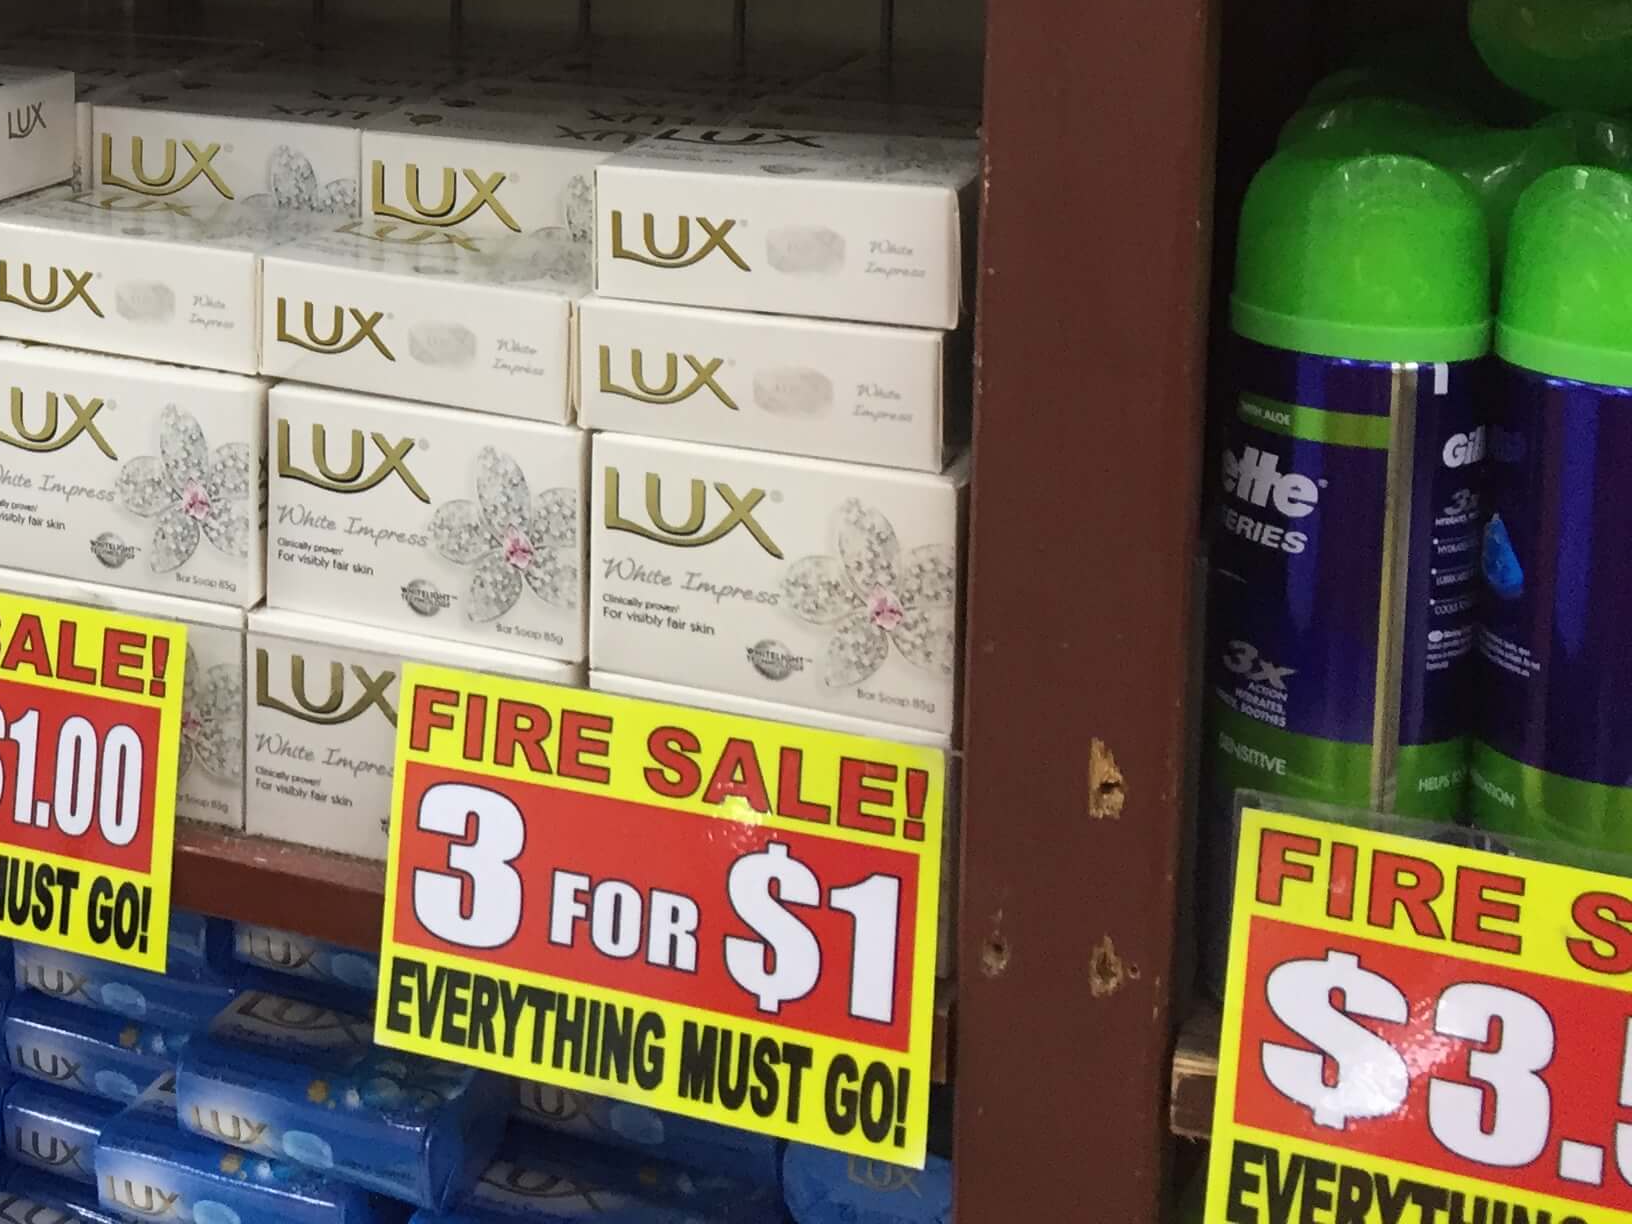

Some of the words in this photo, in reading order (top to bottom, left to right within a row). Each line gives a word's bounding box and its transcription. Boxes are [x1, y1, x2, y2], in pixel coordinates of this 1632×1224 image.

[8, 101, 48, 139] LUX
[277, 418, 431, 505] LUX
[277, 503, 337, 532] White
[345, 516, 430, 550] Impress
[604, 466, 785, 561] LUX
[1221, 504, 1308, 554] ERIES
[603, 557, 673, 587] White
[680, 571, 781, 606] Impress
[603, 607, 623, 621] For
[627, 609, 665, 629] visibly
[667, 613, 686, 631] fair
[690, 620, 716, 636] skin
[409, 684, 614, 785] FIRE
[643, 725, 930, 842] SALE!
[87, 876, 153, 955] GO!
[412, 781, 527, 951] 3
[549, 867, 700, 974] FOR
[724, 840, 901, 1025] $1
[1255, 827, 1526, 955] FIRE
[385, 956, 666, 1092] EVERYTHING
[678, 1019, 814, 1125] MUST
[824, 1053, 911, 1148] GO!
[1261, 948, 1632, 1187] $3.
[191, 1104, 269, 1145] LUX
